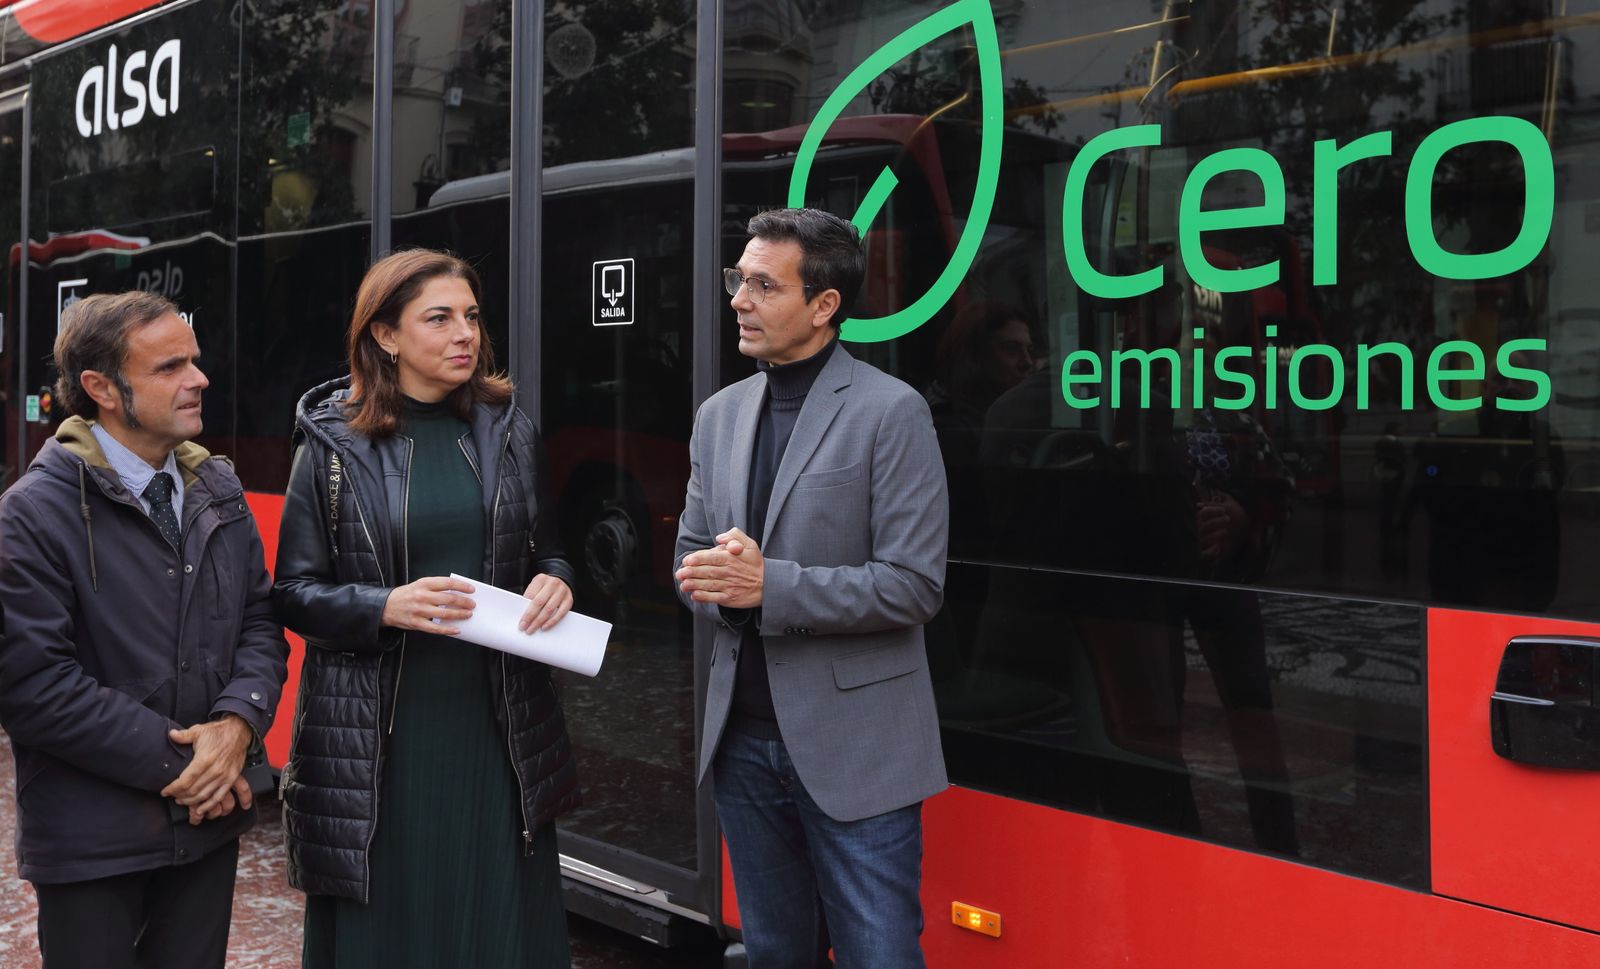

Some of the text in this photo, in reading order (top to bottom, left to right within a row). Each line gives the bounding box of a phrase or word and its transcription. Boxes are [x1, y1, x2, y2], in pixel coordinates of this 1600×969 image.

[75, 39, 181, 138] alsa
[1063, 116, 1554, 298] cero
[601, 307, 625, 318] SALIDA
[1062, 326, 1551, 411] emisiones
[329, 472, 341, 482] &
[330, 451, 341, 472] IMP
[328, 484, 339, 519] DANCE
